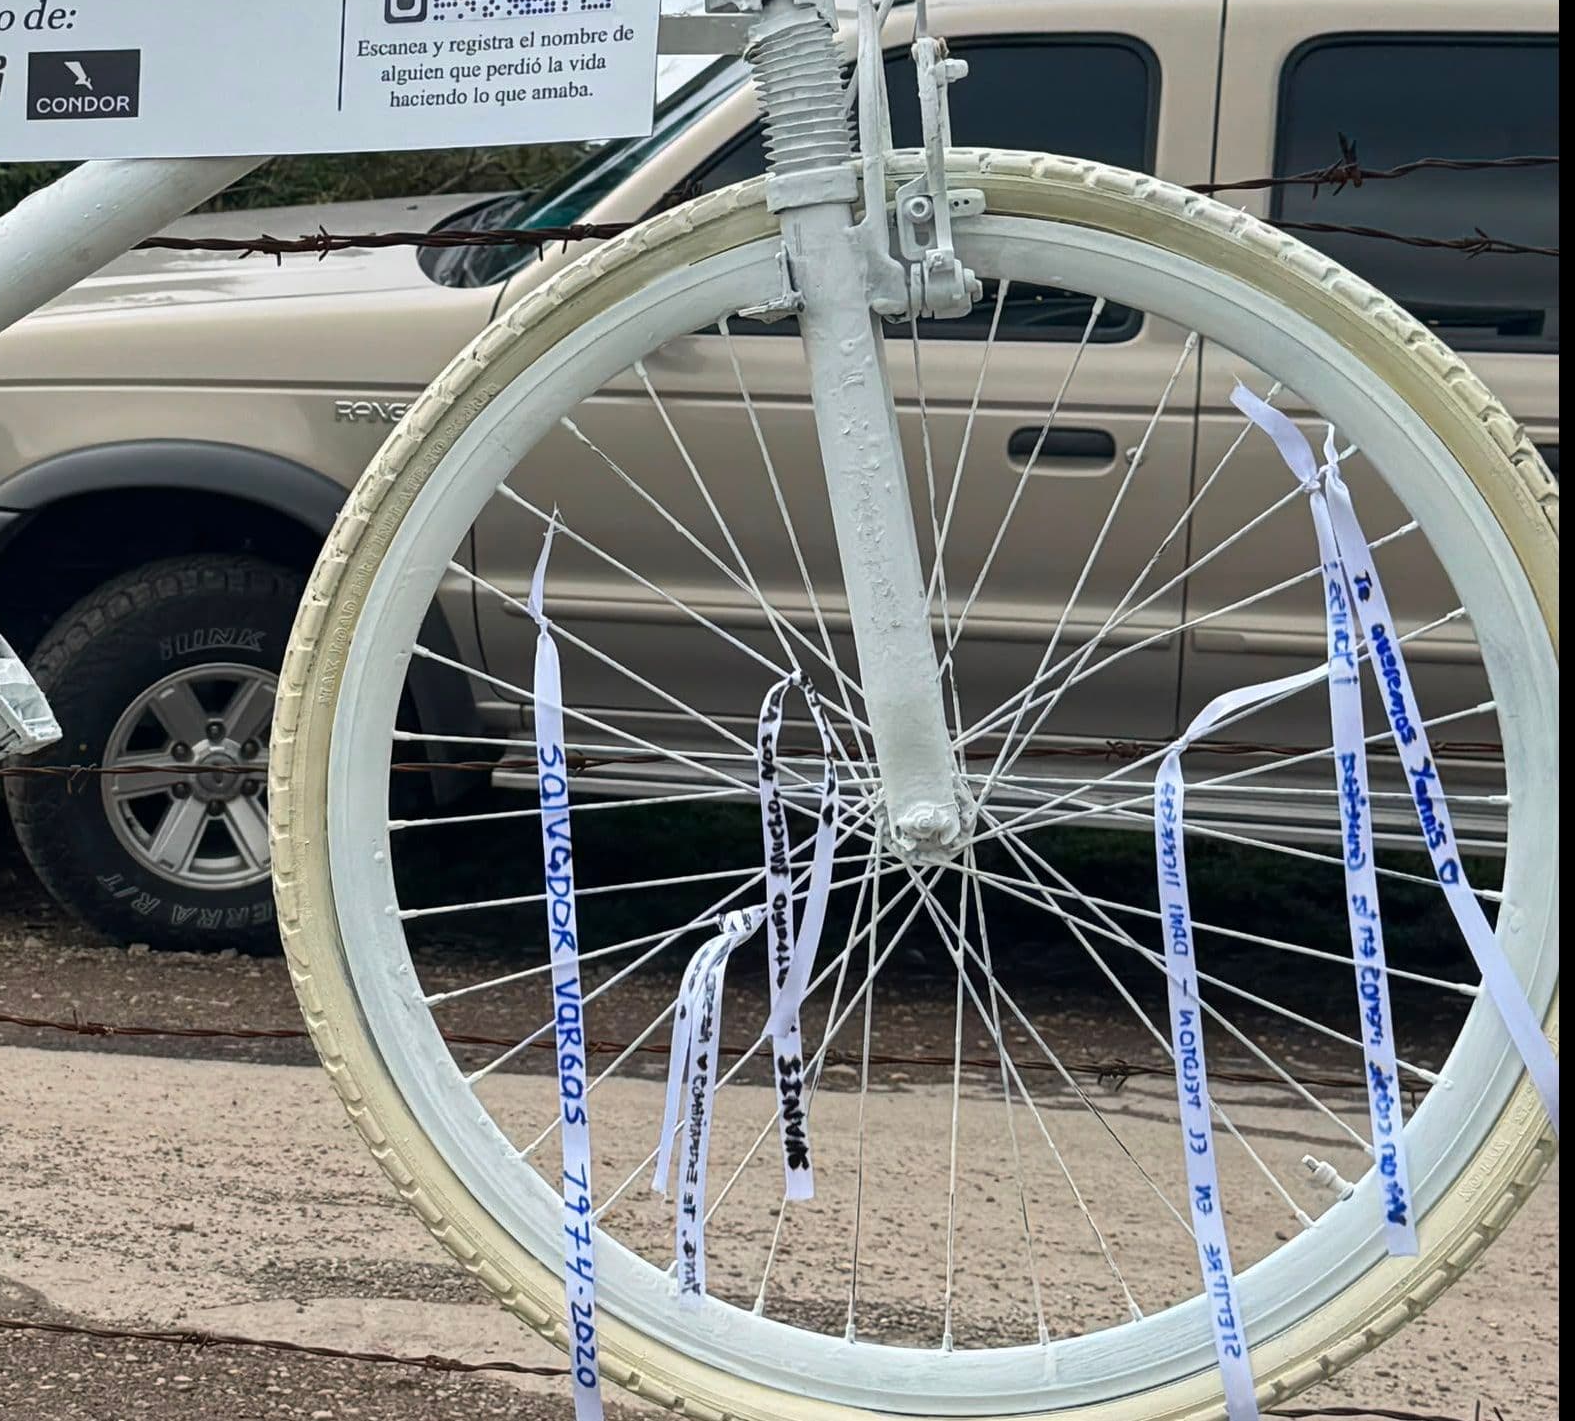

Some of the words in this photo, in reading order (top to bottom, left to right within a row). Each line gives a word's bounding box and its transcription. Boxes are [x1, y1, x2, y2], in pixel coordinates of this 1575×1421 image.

[24, 0, 78, 30] de:
[357, 39, 428, 57] Escanea
[432, 42, 444, 58] y
[448, 34, 514, 56] registra
[519, 31, 535, 48] el
[541, 28, 608, 47] nombre
[613, 24, 634, 42] de
[381, 65, 444, 85] alguien
[449, 64, 481, 82] que
[486, 58, 542, 81] perdió
[548, 56, 563, 73] la
[569, 53, 606, 71] vida
[36, 95, 131, 115] CONDOR
[390, 88, 467, 107] haciendo
[473, 87, 489, 103] lo
[494, 87, 526, 107] que
[532, 81, 594, 100] amaba.
[334, 400, 416, 423] RANG
[1351, 568, 1376, 602] Te
[170, 900, 272, 930] ERRA
